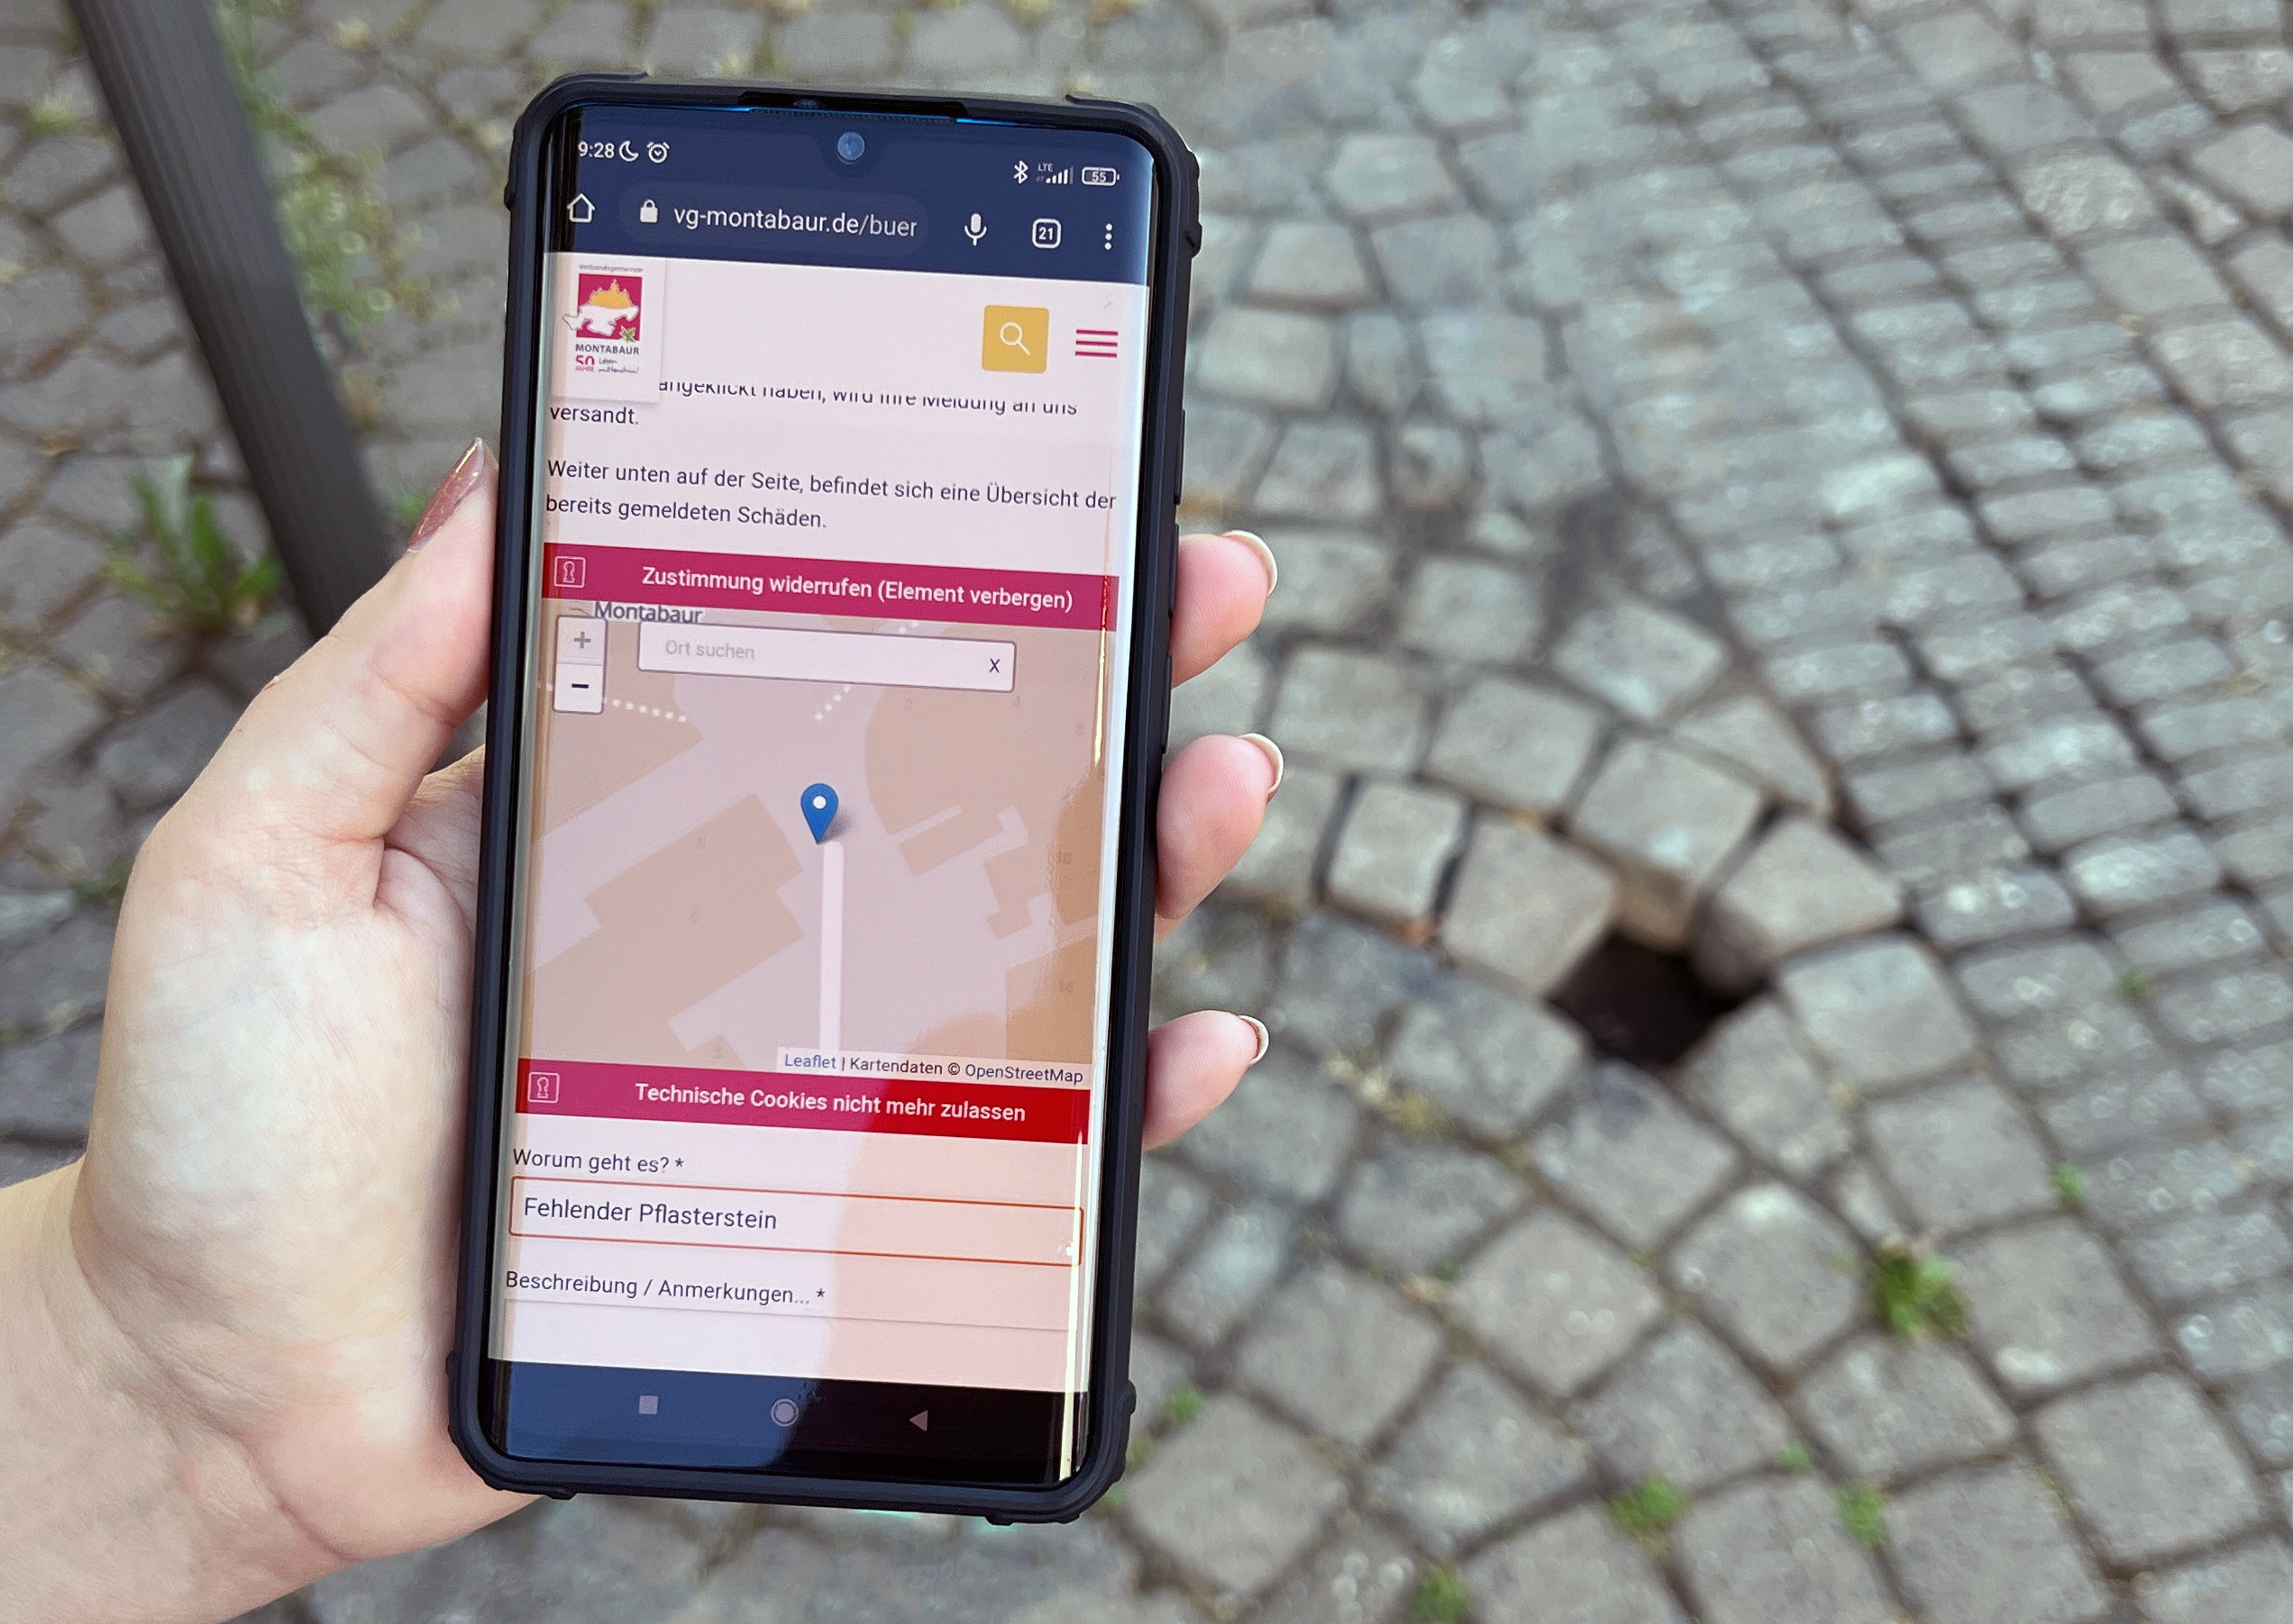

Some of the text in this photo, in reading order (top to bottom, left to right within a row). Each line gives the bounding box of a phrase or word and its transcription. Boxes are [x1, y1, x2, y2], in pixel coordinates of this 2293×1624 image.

[578, 142, 615, 158] 9:28
[1038, 163, 1054, 172] LTE
[1092, 172, 1107, 183] 55
[674, 207, 917, 238] vg-montabaur.de/buer
[1038, 227, 1054, 240] 21
[575, 344, 639, 354] MONTABAUR
[550, 407, 639, 425] versandt.
[548, 460, 1116, 509] Weiter unten auf der Seite, befindet sich eine Übersicht der
[546, 495, 826, 528] bereits gemeldeten Schäden.
[642, 566, 1073, 613] Zustimmung widerrufen (Element verbergen)
[595, 601, 703, 624] Montabaur
[666, 640, 755, 659] Ort suchen
[784, 1053, 837, 1070] Leaflet
[850, 1058, 943, 1075] Kartendaten
[965, 1064, 1084, 1084] OpenStreetMap
[635, 1083, 1025, 1122] Technische Cookies nicht mehr zulassen
[513, 1148, 669, 1173] Worum geht es?
[525, 1197, 777, 1229] Fehlender Pflasterstein
[506, 1270, 637, 1298] Beschreibung
[658, 1280, 810, 1305] Anmerkungen...
